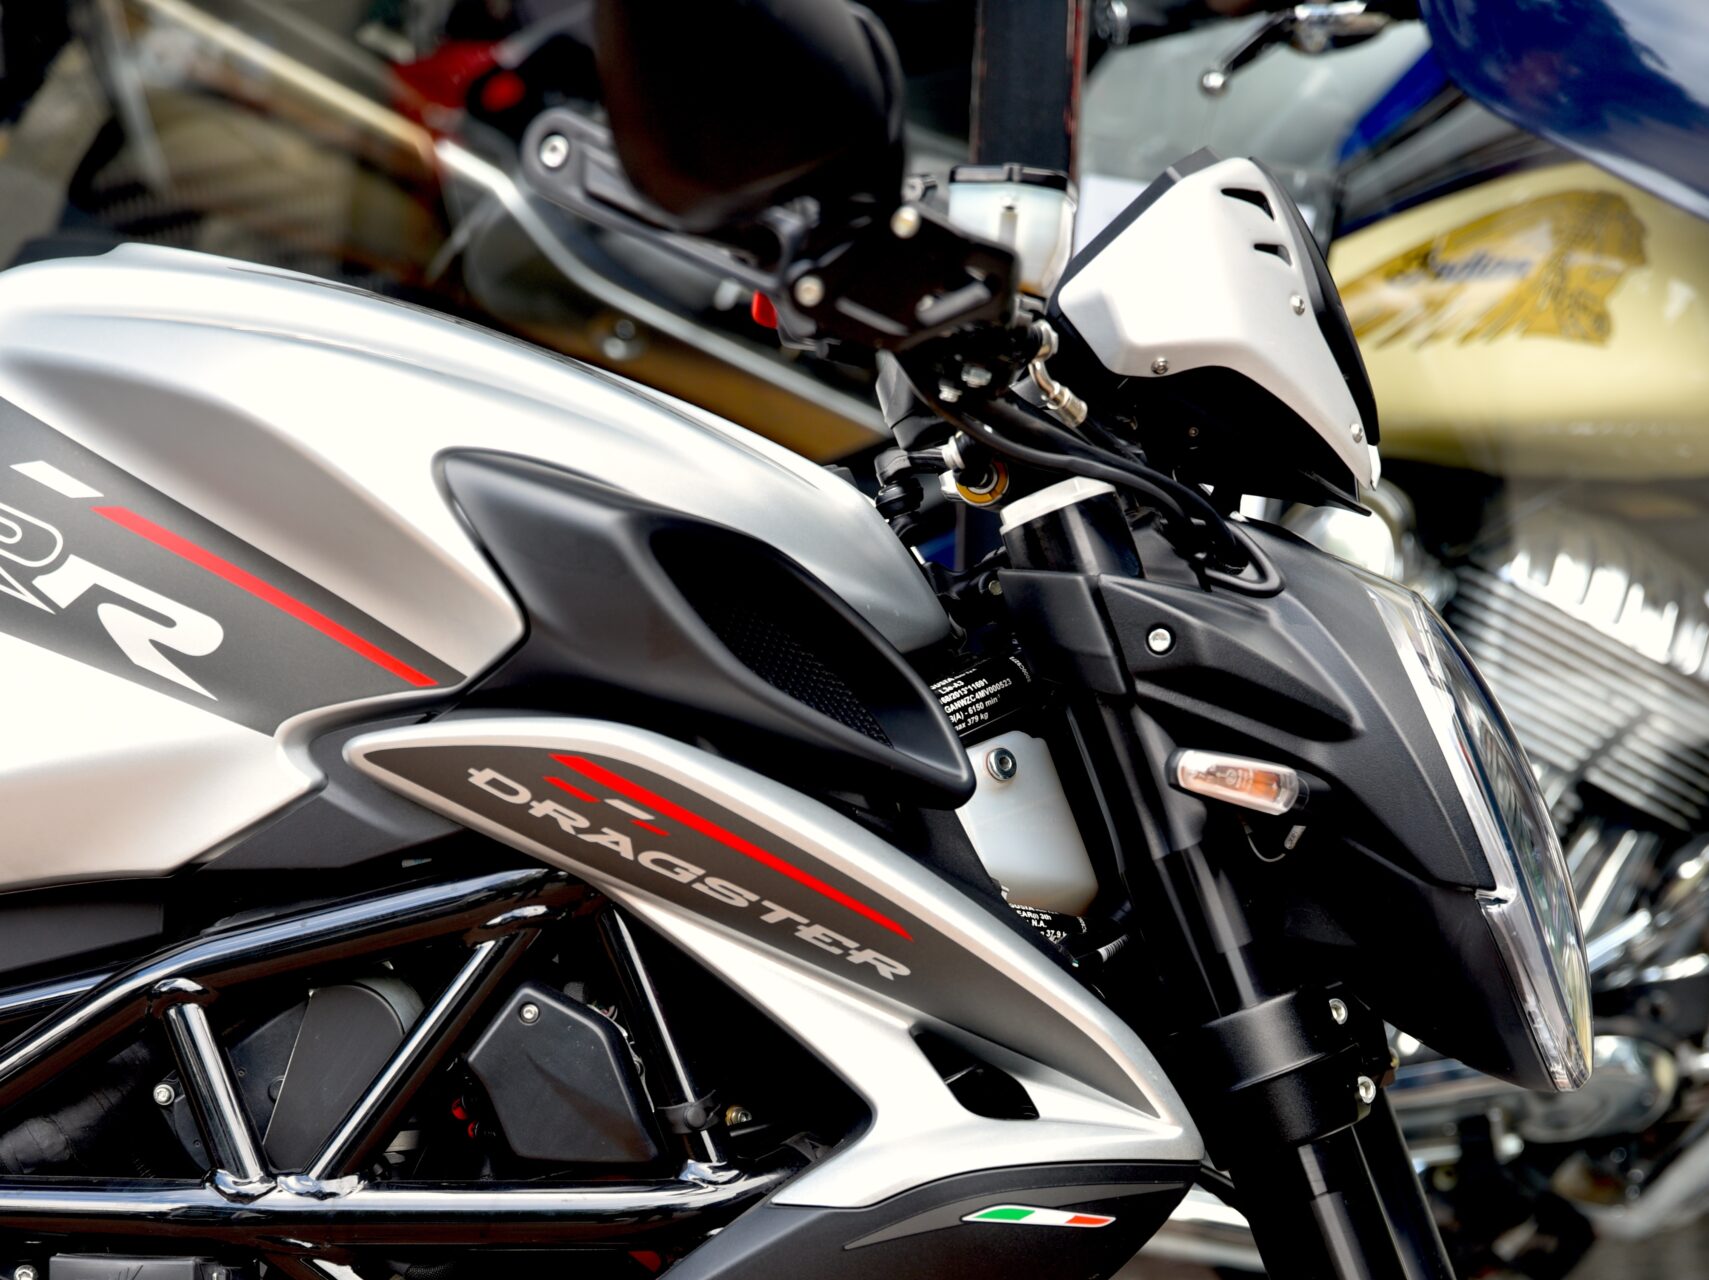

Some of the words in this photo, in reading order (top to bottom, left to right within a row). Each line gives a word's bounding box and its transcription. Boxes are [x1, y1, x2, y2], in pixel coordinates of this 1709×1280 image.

[968, 702, 985, 715] 6150
[967, 715, 980, 726] 379
[467, 767, 911, 981] DRAGSTER
